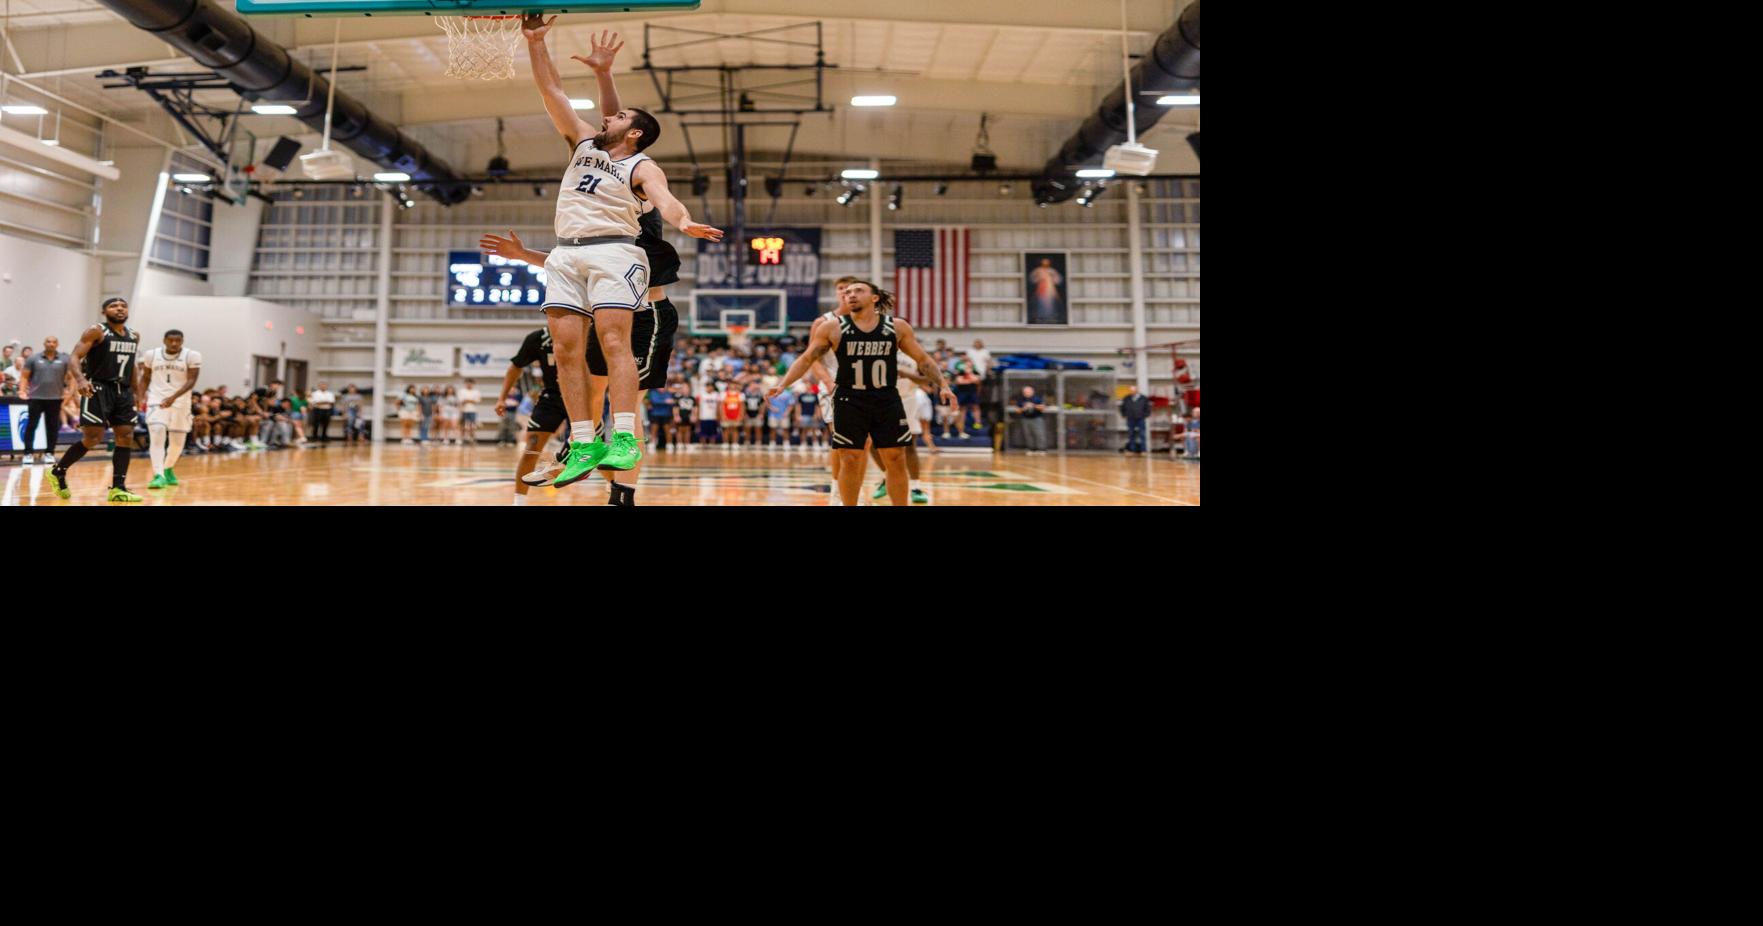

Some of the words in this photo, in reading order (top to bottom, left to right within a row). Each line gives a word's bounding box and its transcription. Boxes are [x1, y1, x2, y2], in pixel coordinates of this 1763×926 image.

[575, 174, 602, 195] 21
[846, 340, 892, 356] WEBBER
[116, 354, 130, 378] 7
[851, 359, 888, 391] 10
